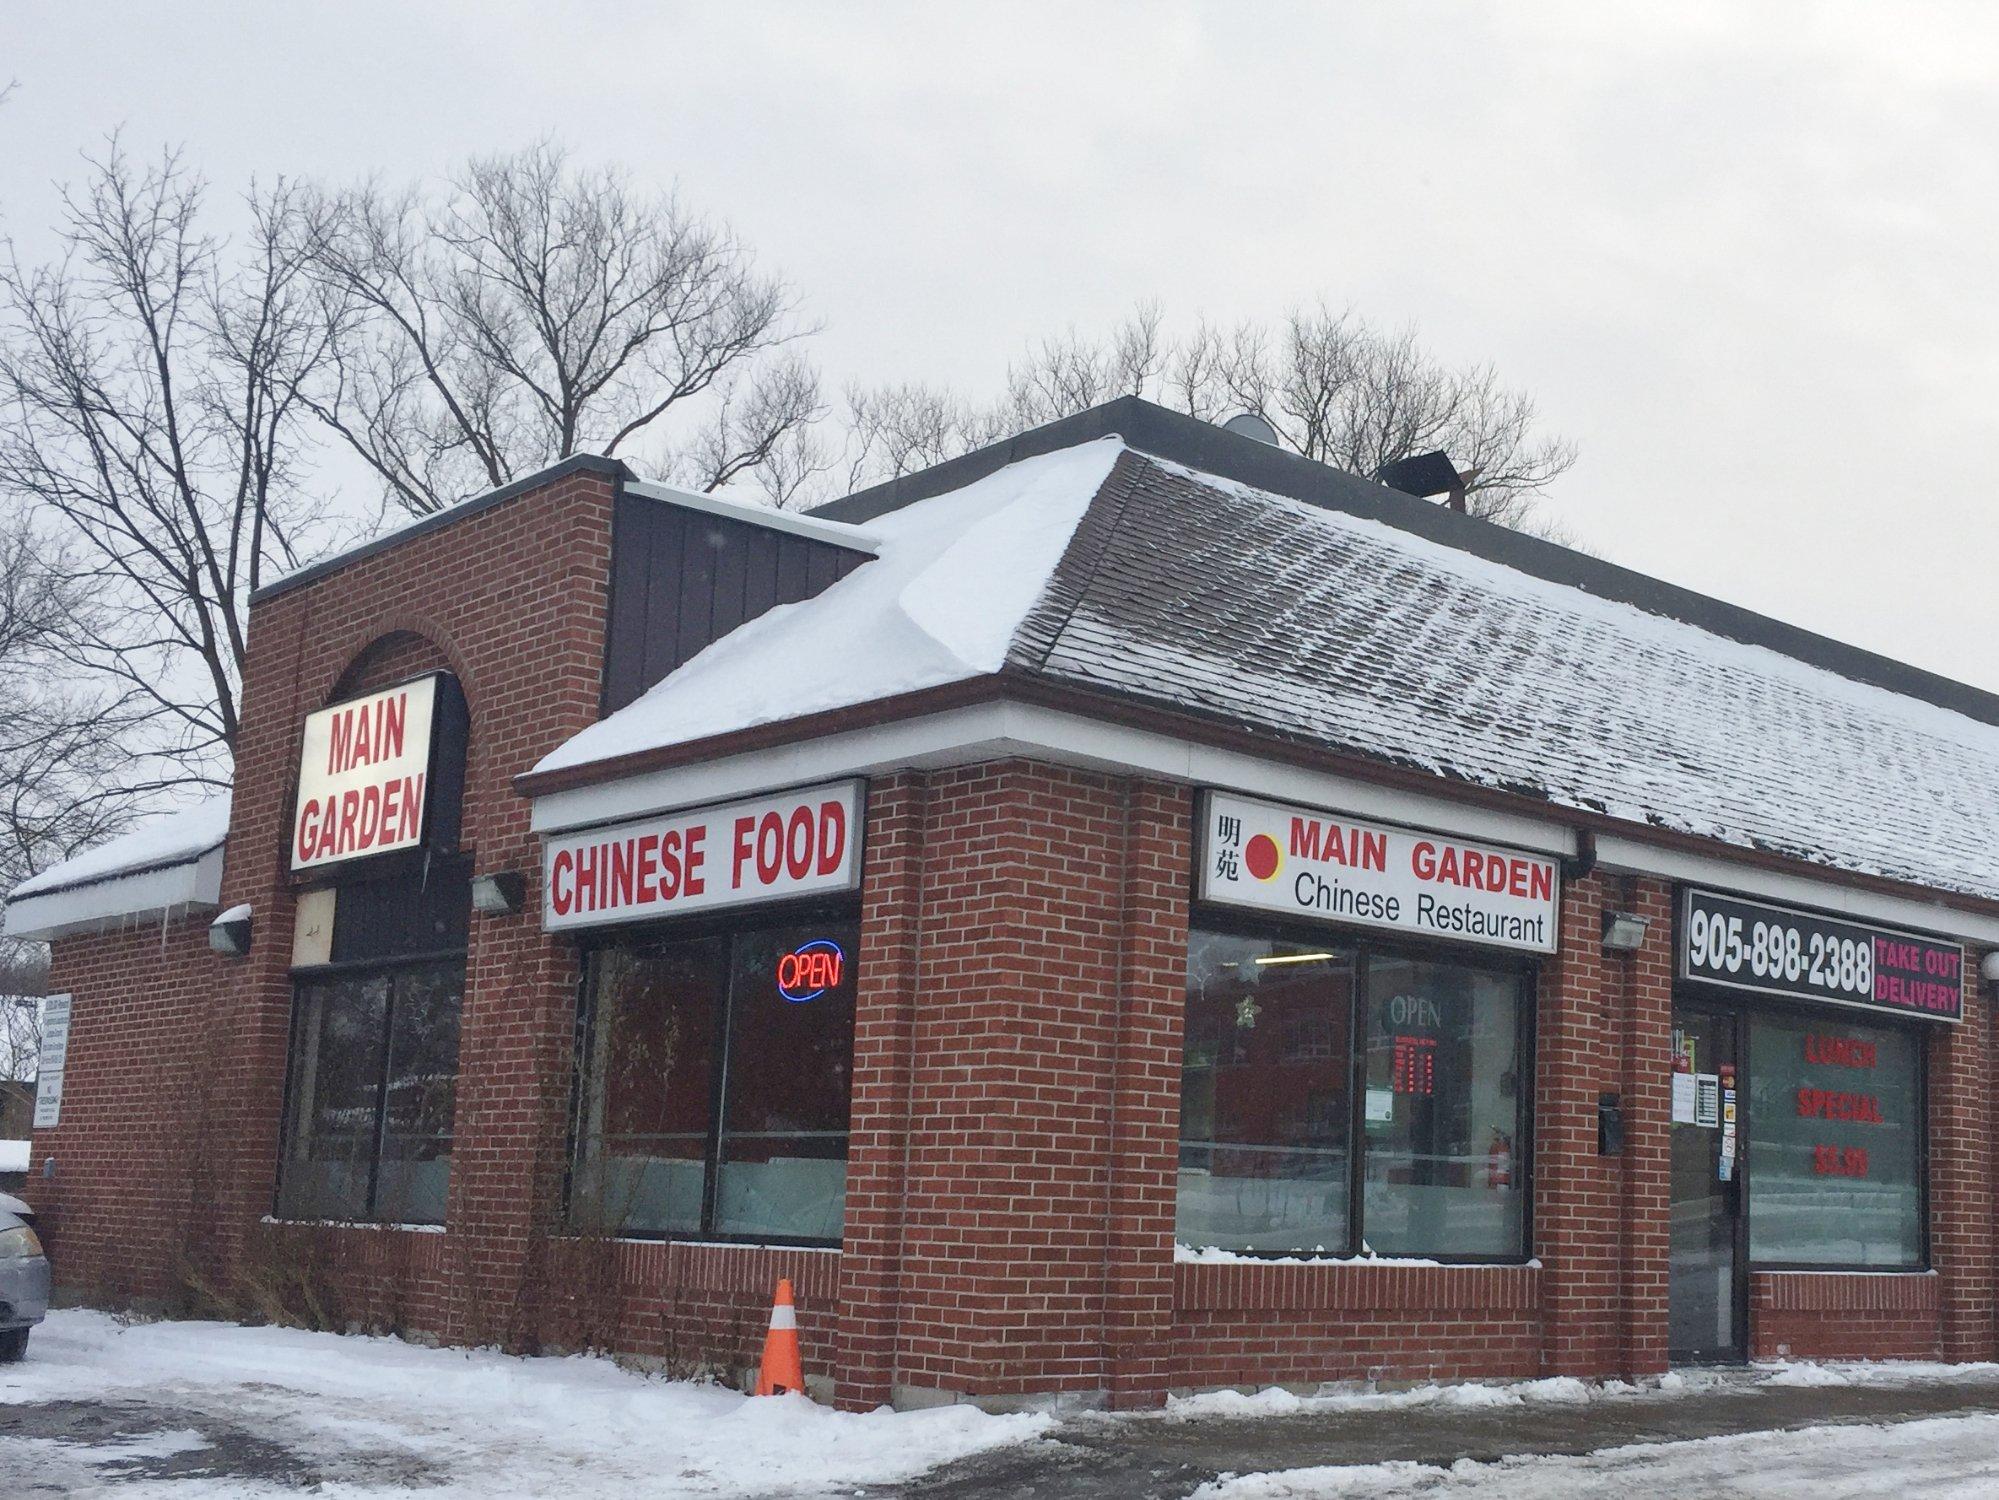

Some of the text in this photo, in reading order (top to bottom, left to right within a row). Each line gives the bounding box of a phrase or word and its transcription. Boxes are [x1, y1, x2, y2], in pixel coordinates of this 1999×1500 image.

[328, 693, 407, 775] MAIN
[299, 773, 424, 862] GARDEN
[1216, 815, 1241, 883] 明苑
[552, 801, 846, 915] CHINESE FOOD
[1290, 817, 1552, 901] MAIN GARDEN
[1295, 872, 1543, 943] Chinese Restaurant
[777, 952, 842, 989] OPEN
[1690, 909, 1871, 995] 905-898-2388
[1876, 938, 1960, 980] TAKE OUT
[1391, 995, 1441, 1028] OPEN
[1876, 974, 1960, 1012] DELIVERY
[1805, 1034, 1876, 1069] LUNCH
[1797, 1087, 1884, 1125] SPECIAL
